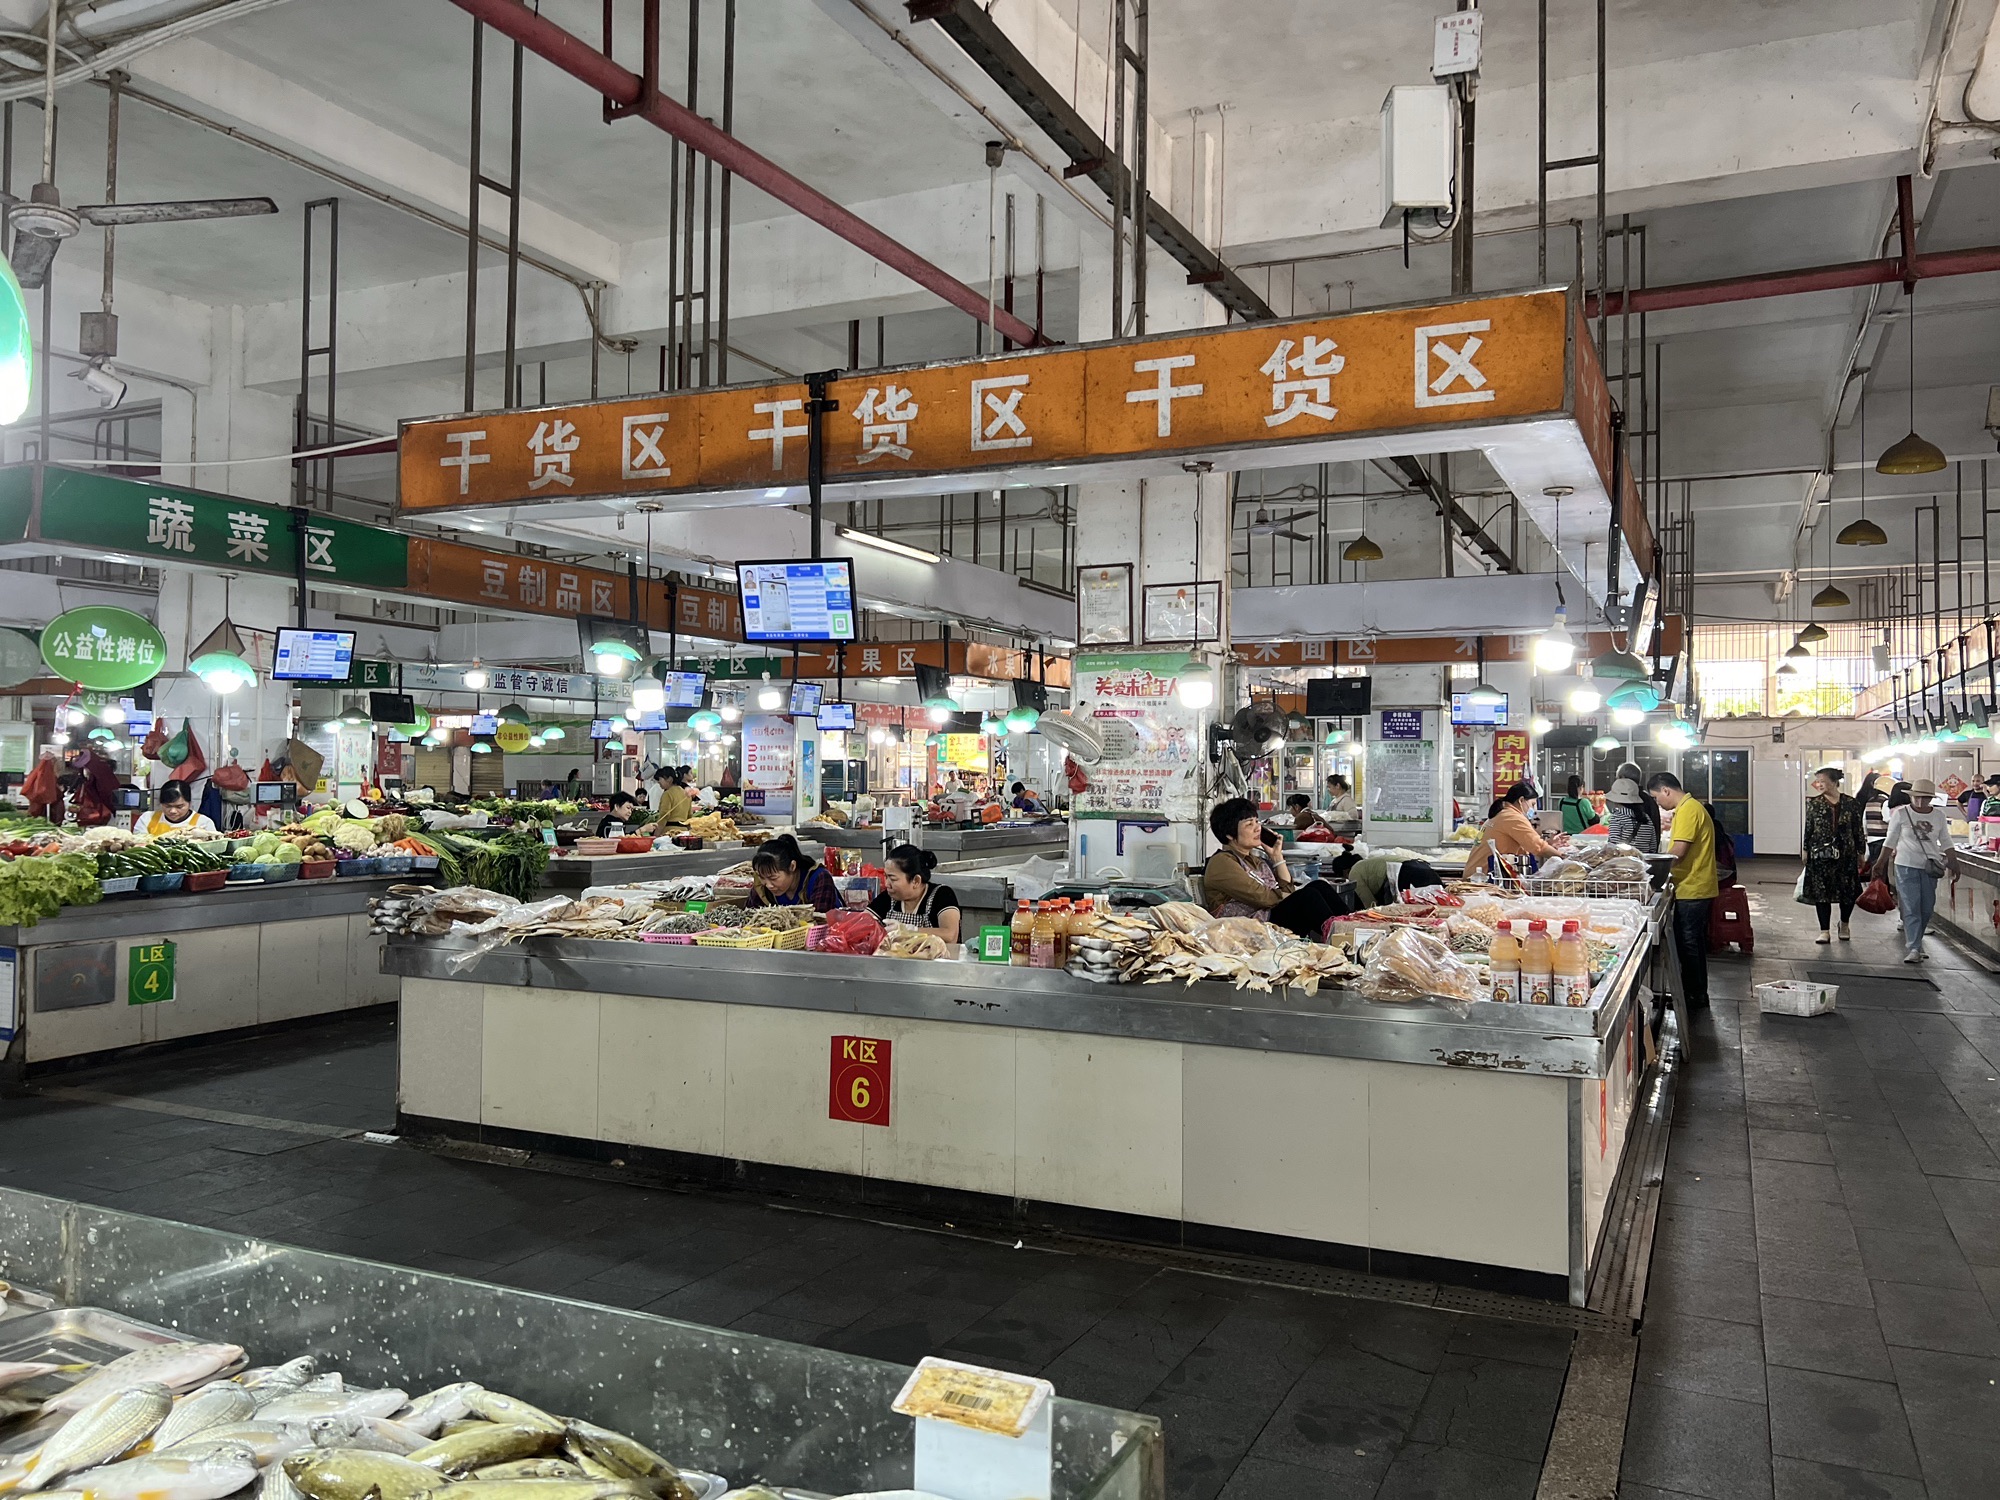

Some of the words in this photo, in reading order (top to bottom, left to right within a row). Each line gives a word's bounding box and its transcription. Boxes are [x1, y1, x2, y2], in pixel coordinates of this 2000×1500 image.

[440, 412, 671, 495] 干货区
[748, 374, 1033, 471] 干货区
[1126, 318, 1496, 438] 干货区
[147, 497, 337, 573] 蔬菜区
[480, 559, 615, 617] 豆制品区
[53, 631, 156, 665] 公益性摊位
[827, 648, 916, 673] 水果区
[1095, 671, 1180, 697] 关爱未成年人
[139, 945, 165, 963] L区
[143, 969, 160, 994] 4
[843, 1039, 878, 1064] K区
[851, 1076, 870, 1108] 6
